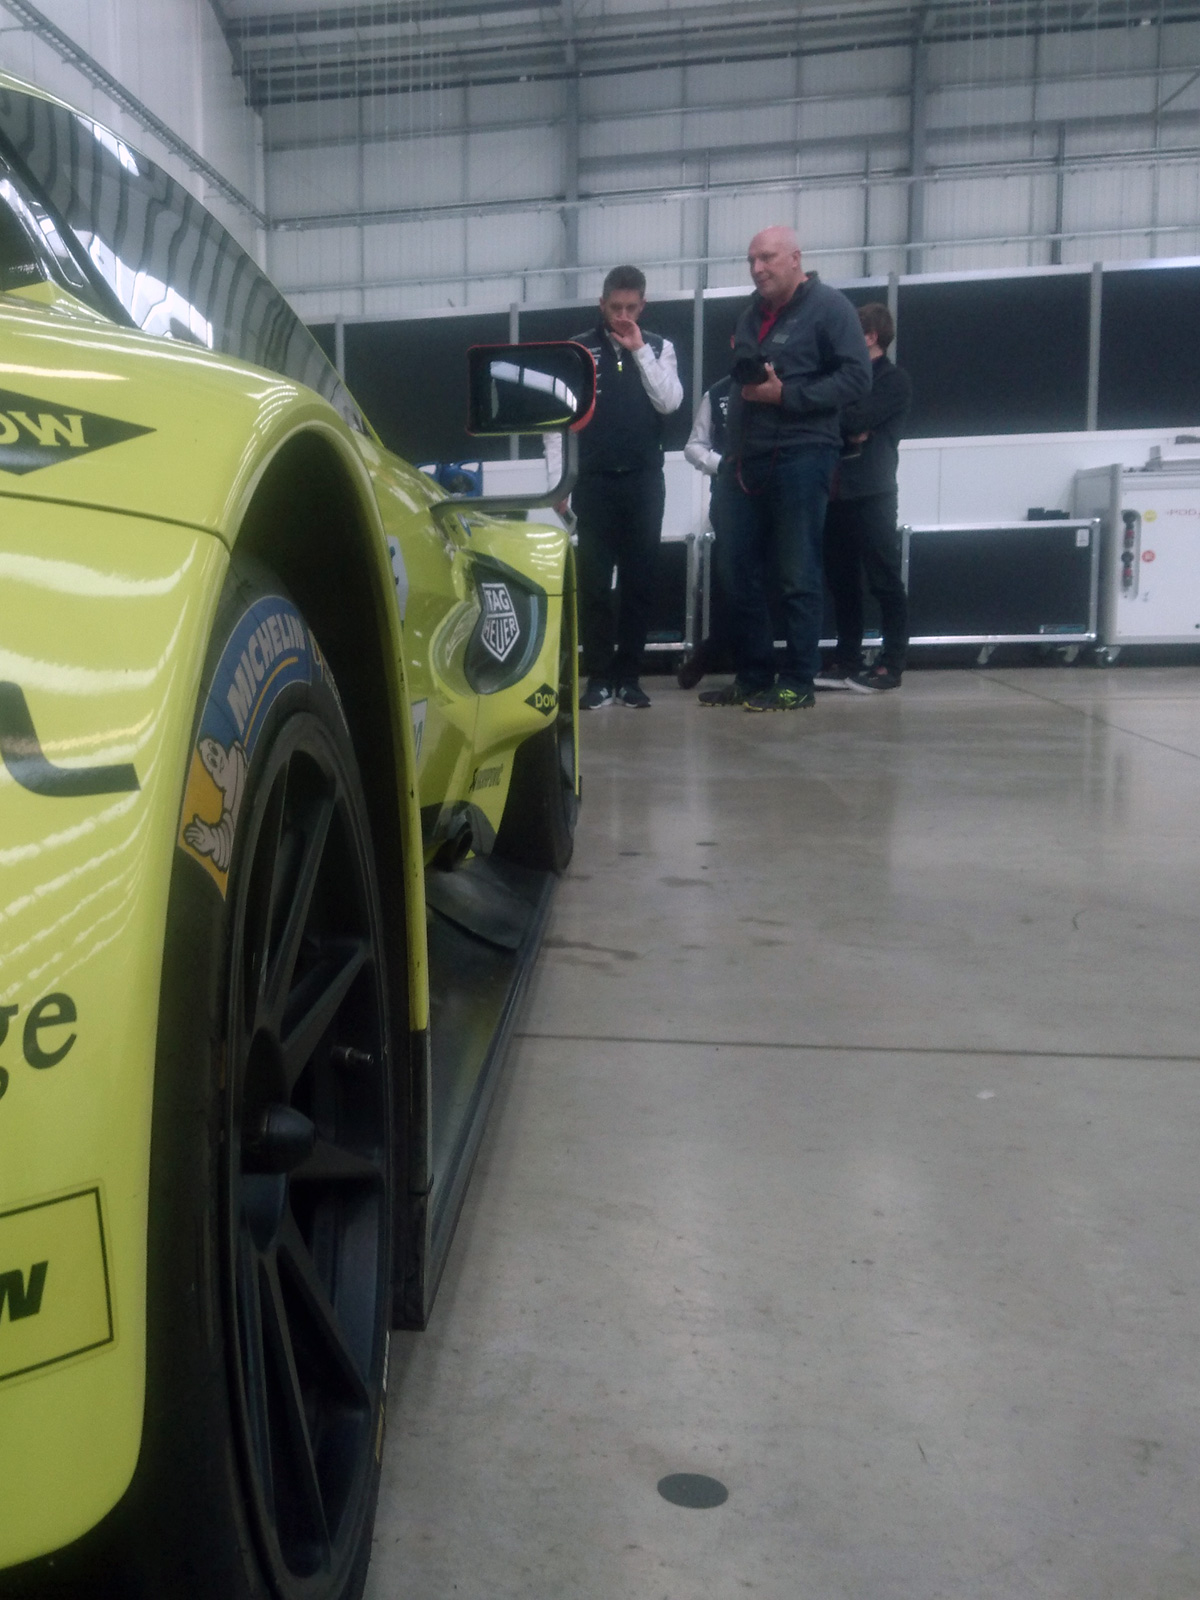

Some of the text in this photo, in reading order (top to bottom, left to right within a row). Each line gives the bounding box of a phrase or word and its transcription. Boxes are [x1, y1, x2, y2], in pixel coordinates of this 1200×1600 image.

[484, 589, 511, 612] TAG
[482, 617, 517, 654] HEUER
[226, 612, 306, 736] MICHELIN
